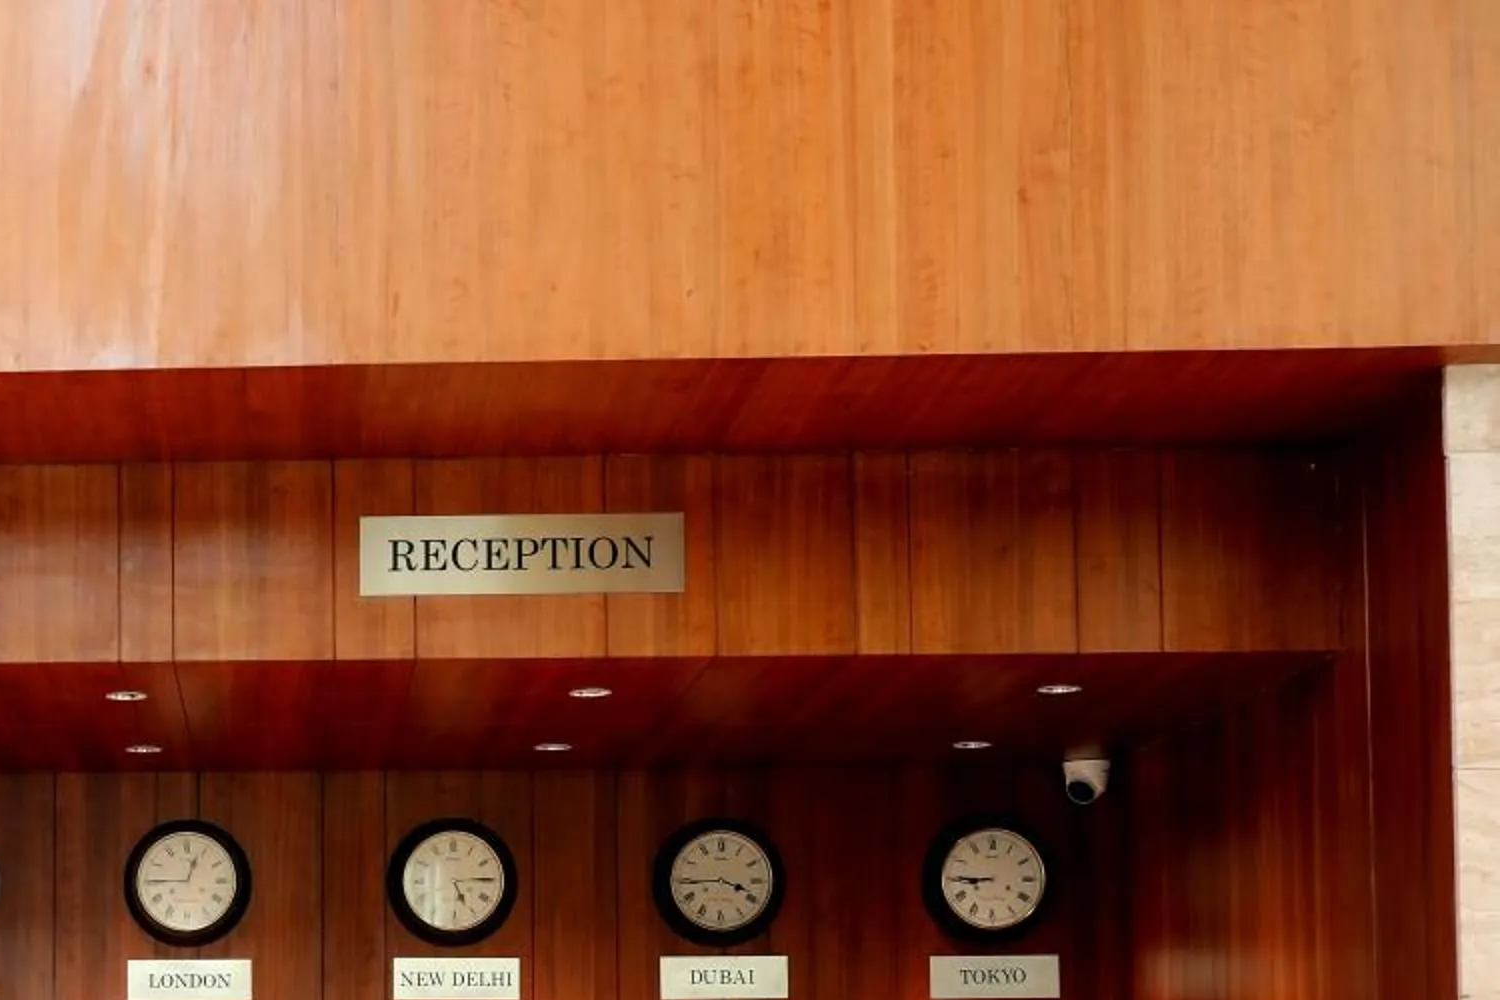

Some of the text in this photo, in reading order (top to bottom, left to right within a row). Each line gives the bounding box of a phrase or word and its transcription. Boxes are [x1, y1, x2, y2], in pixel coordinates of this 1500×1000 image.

[388, 536, 654, 572] RECEPTION
[148, 973, 232, 989] LONDON
[400, 971, 512, 987] NEW DELHI
[690, 969, 755, 985] DUBAI
[959, 967, 1027, 985] TOKYO
